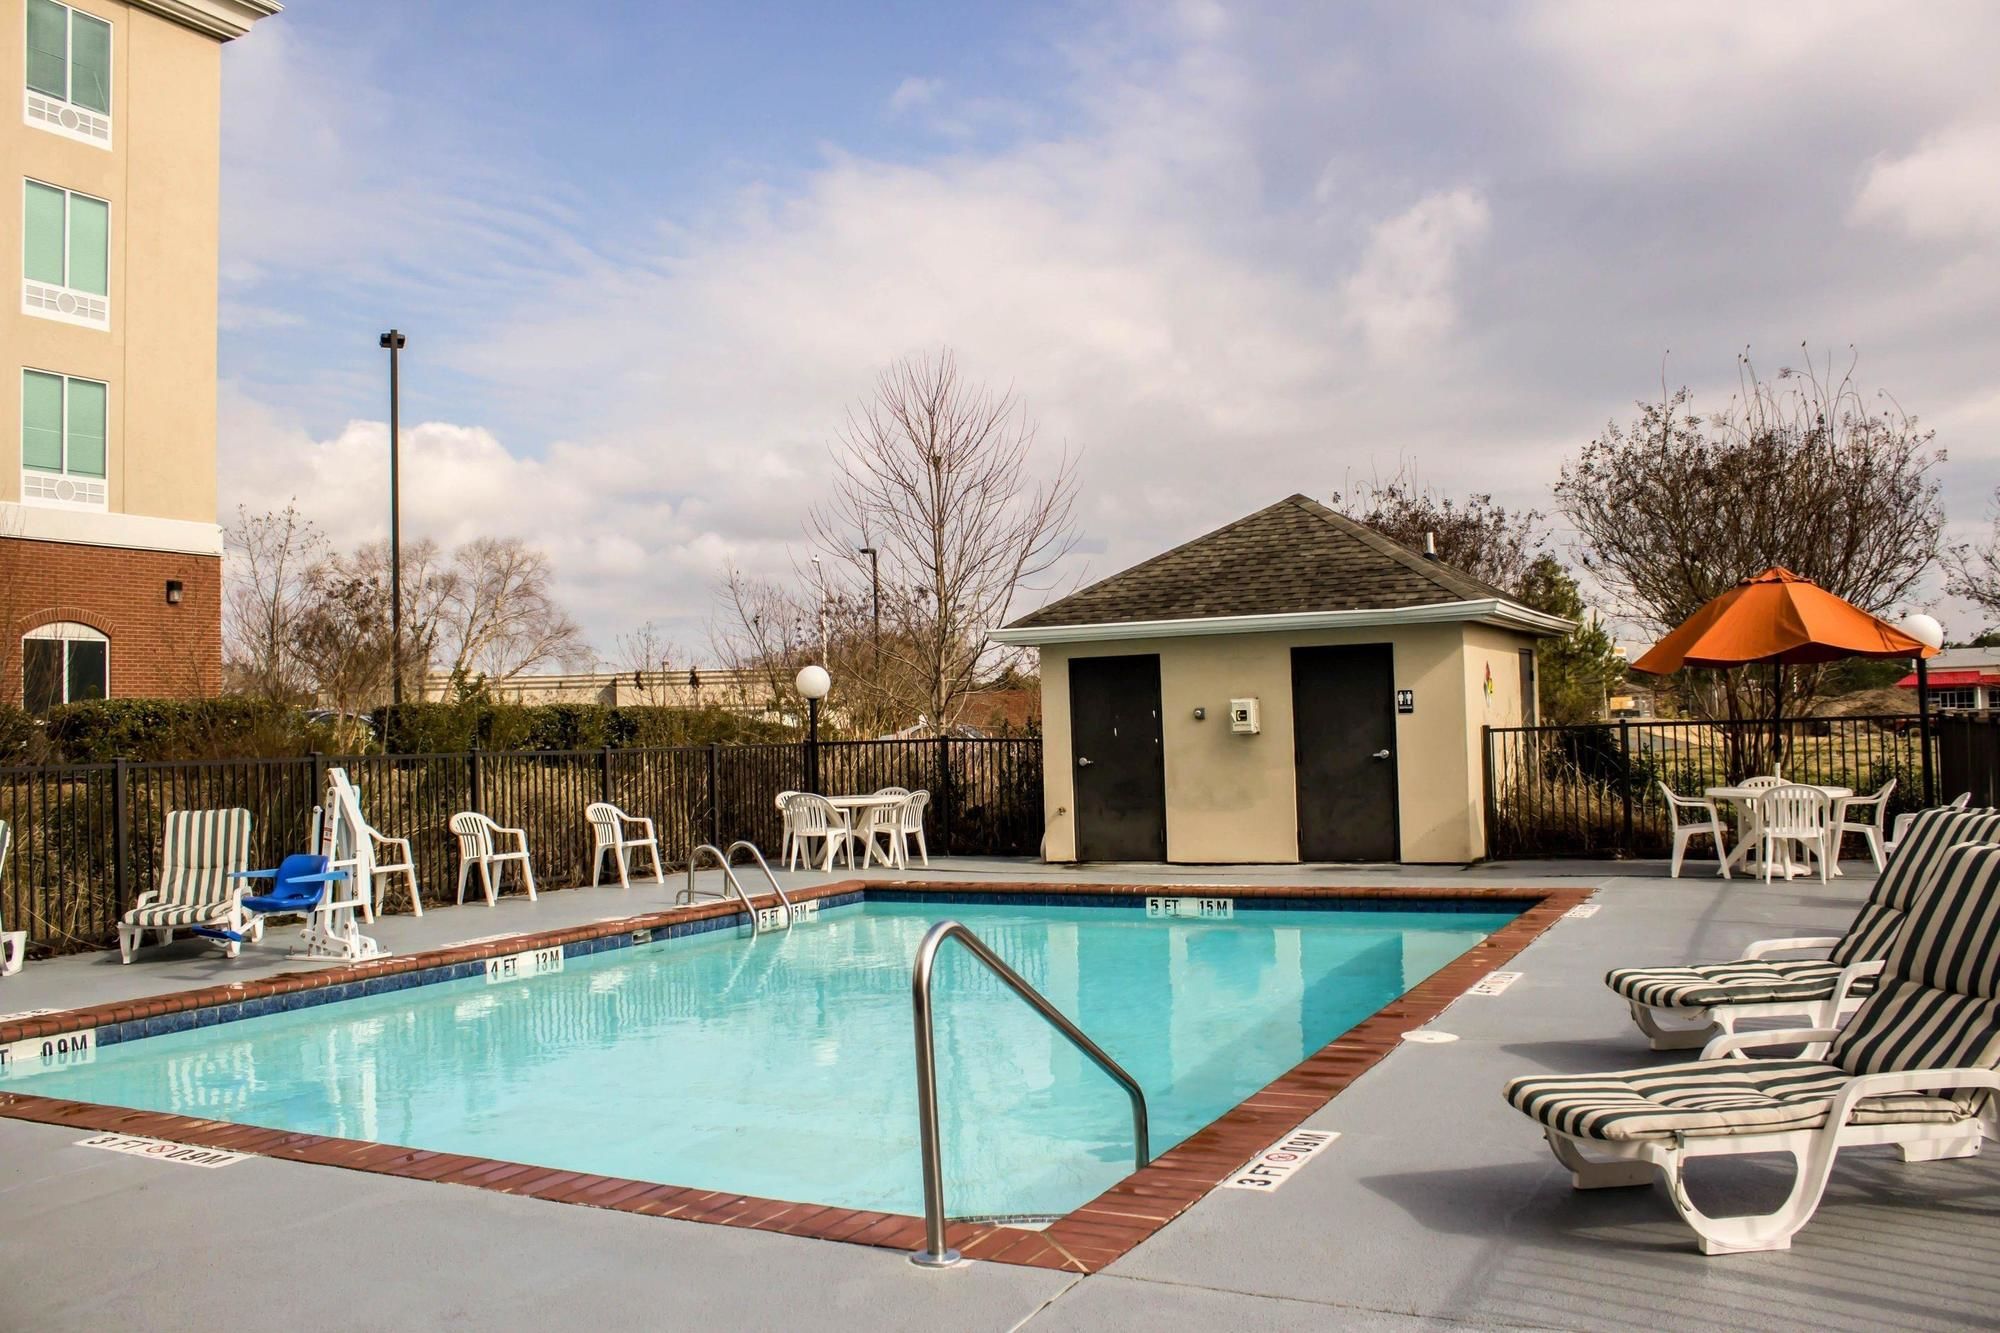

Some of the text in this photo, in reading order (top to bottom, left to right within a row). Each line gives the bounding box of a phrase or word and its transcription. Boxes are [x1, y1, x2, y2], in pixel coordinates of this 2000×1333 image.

[1150, 899, 1159, 910] 5
[1164, 899, 1179, 910] FT
[761, 911, 768, 922] 5
[770, 909, 779, 922] FT
[503, 957, 517, 971] FT
[0, 1048, 9, 1065] T
[87, 1136, 235, 1165] 3 FT 09M
[1248, 1163, 1291, 1177] FT
[1236, 1178, 1272, 1187] 3
